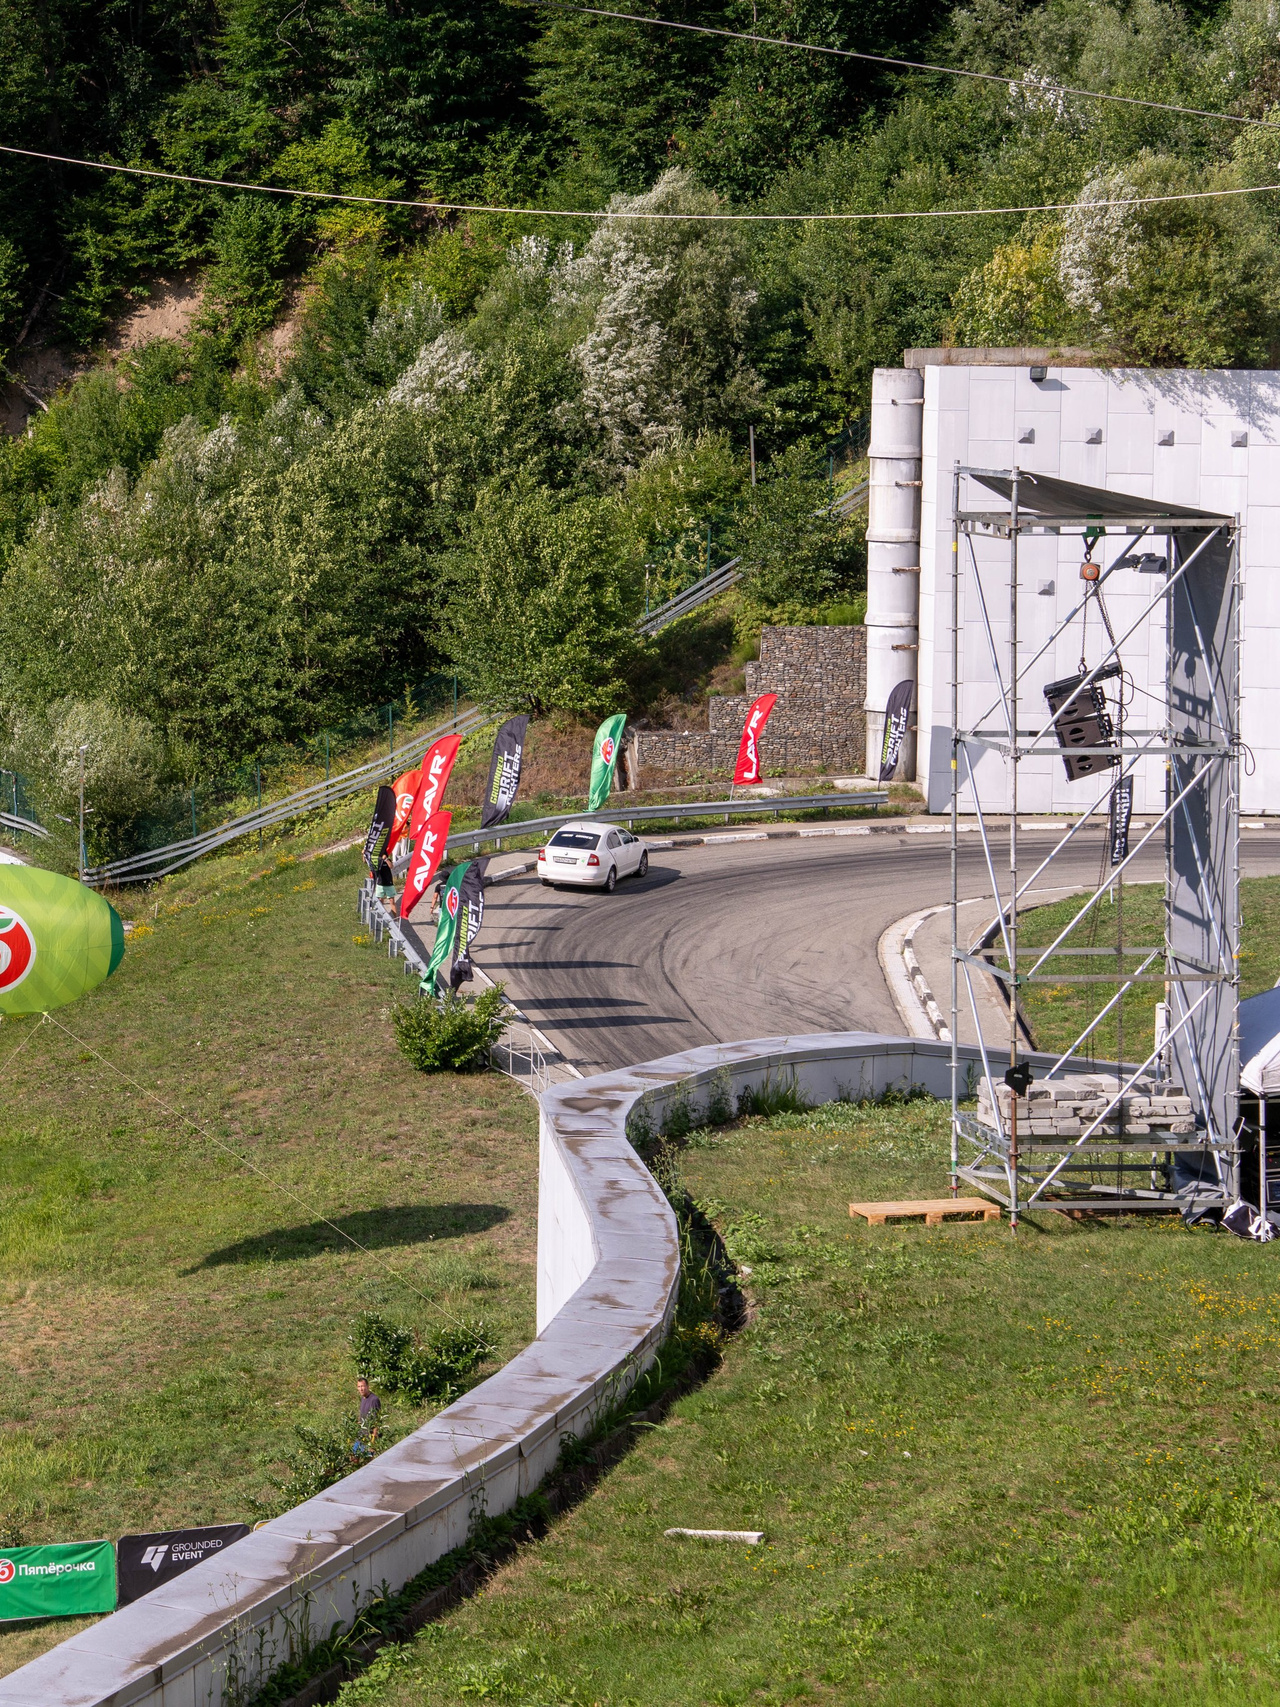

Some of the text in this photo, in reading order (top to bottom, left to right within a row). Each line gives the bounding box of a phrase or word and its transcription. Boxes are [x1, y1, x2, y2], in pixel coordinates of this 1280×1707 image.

[489, 755, 504, 805] GROUNDED
[497, 751, 514, 809] DRIFT
[467, 900, 480, 943] RIFT
[171, 1539, 223, 1553] GROUNDED
[171, 1550, 204, 1561] EVENT
[18, 1561, 96, 1576] Пятёрочка
